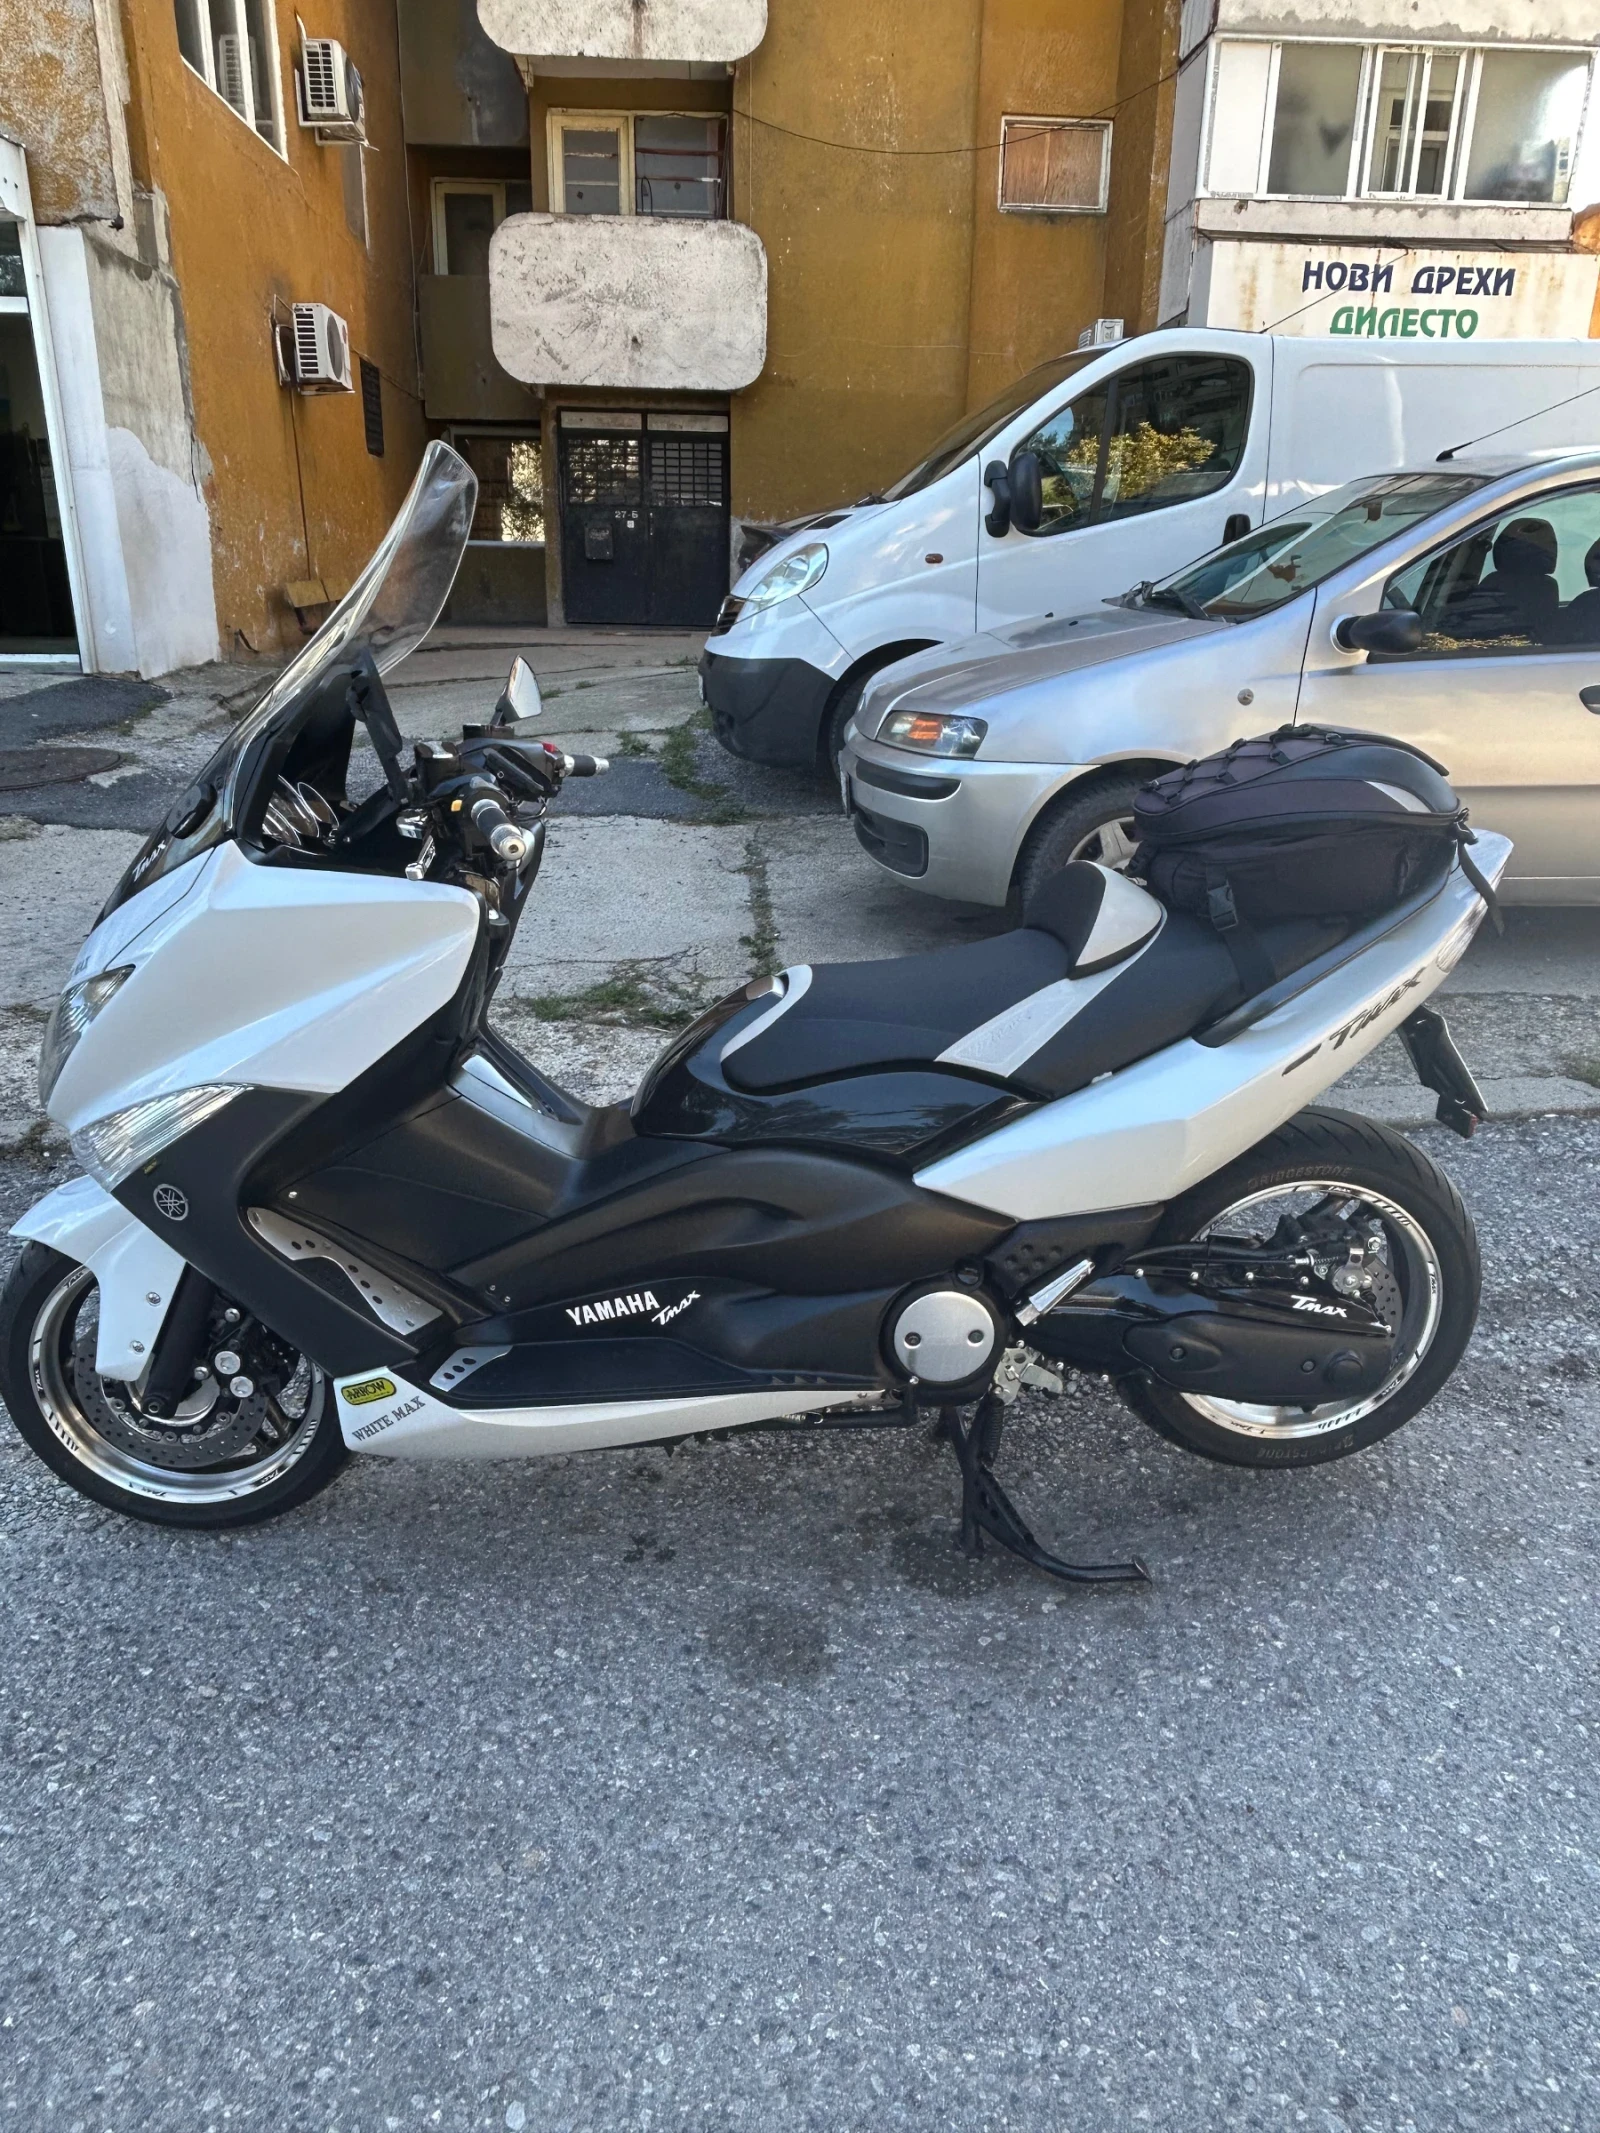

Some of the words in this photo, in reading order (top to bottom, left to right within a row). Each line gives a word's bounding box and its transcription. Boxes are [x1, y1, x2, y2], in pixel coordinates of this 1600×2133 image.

[1303, 261, 1393, 293] НОВИ
[1411, 266, 1515, 296] ДРЕХИ
[1331, 306, 1478, 338] ДИЛЕСТО
[566, 1291, 660, 1326] YAMAHA
[345, 1380, 386, 1400] ARROW
[352, 1415, 393, 1441] WHITE
[392, 1396, 426, 1421] MAX
